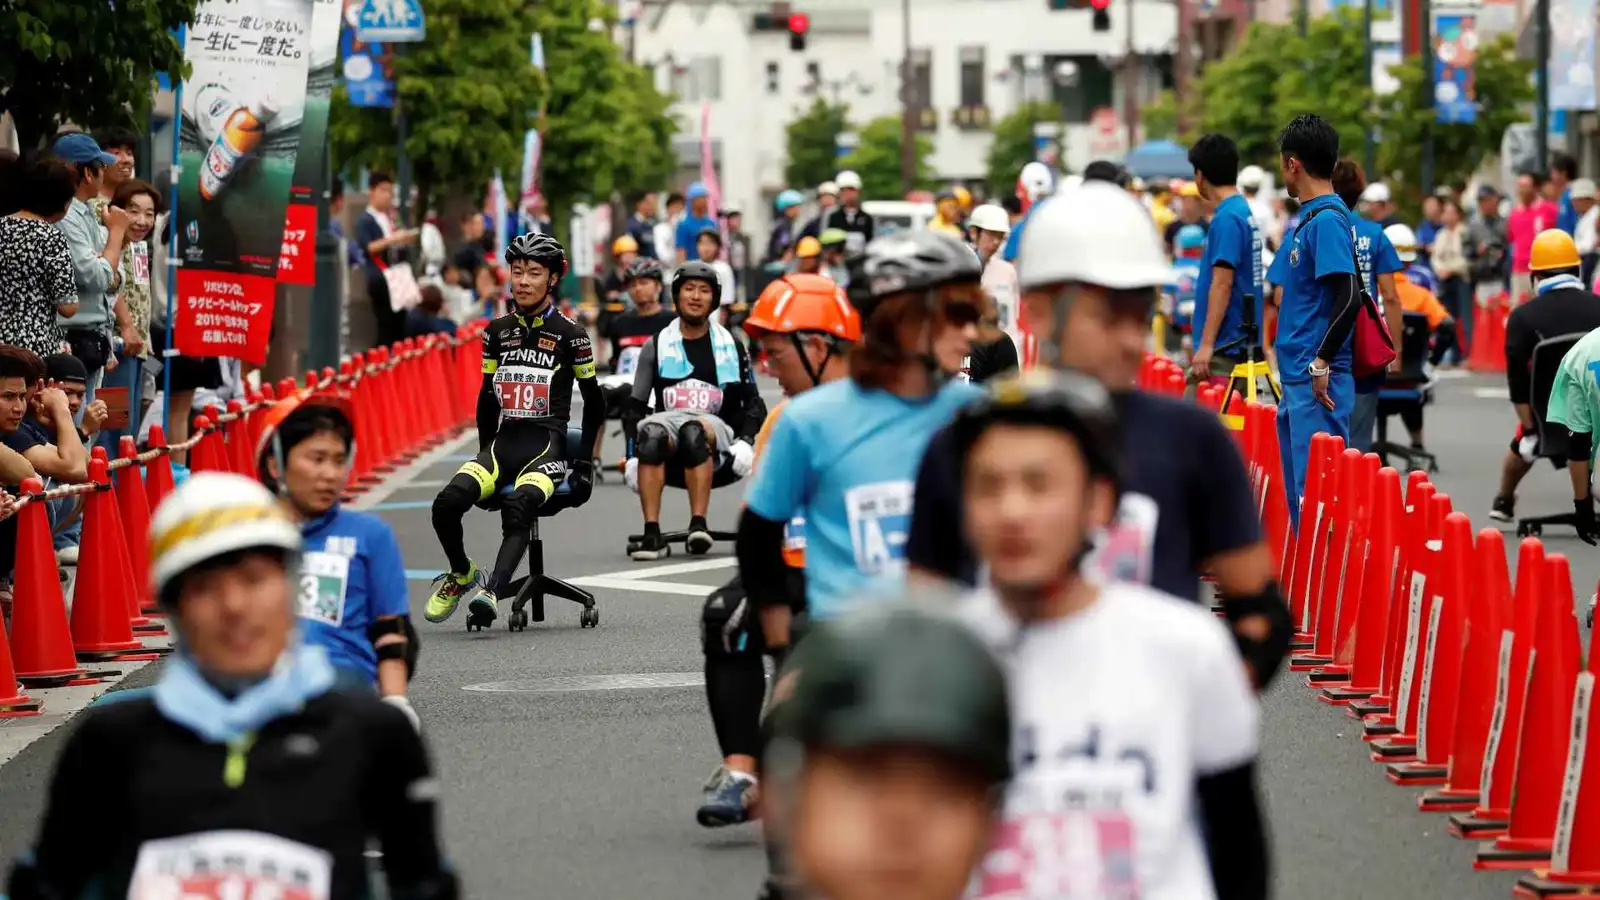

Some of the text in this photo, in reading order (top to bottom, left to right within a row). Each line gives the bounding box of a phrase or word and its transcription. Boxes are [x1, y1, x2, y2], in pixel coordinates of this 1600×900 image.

[190, 31, 302, 59] 一生に一度だ。
[500, 348, 555, 368] ZENRIN
